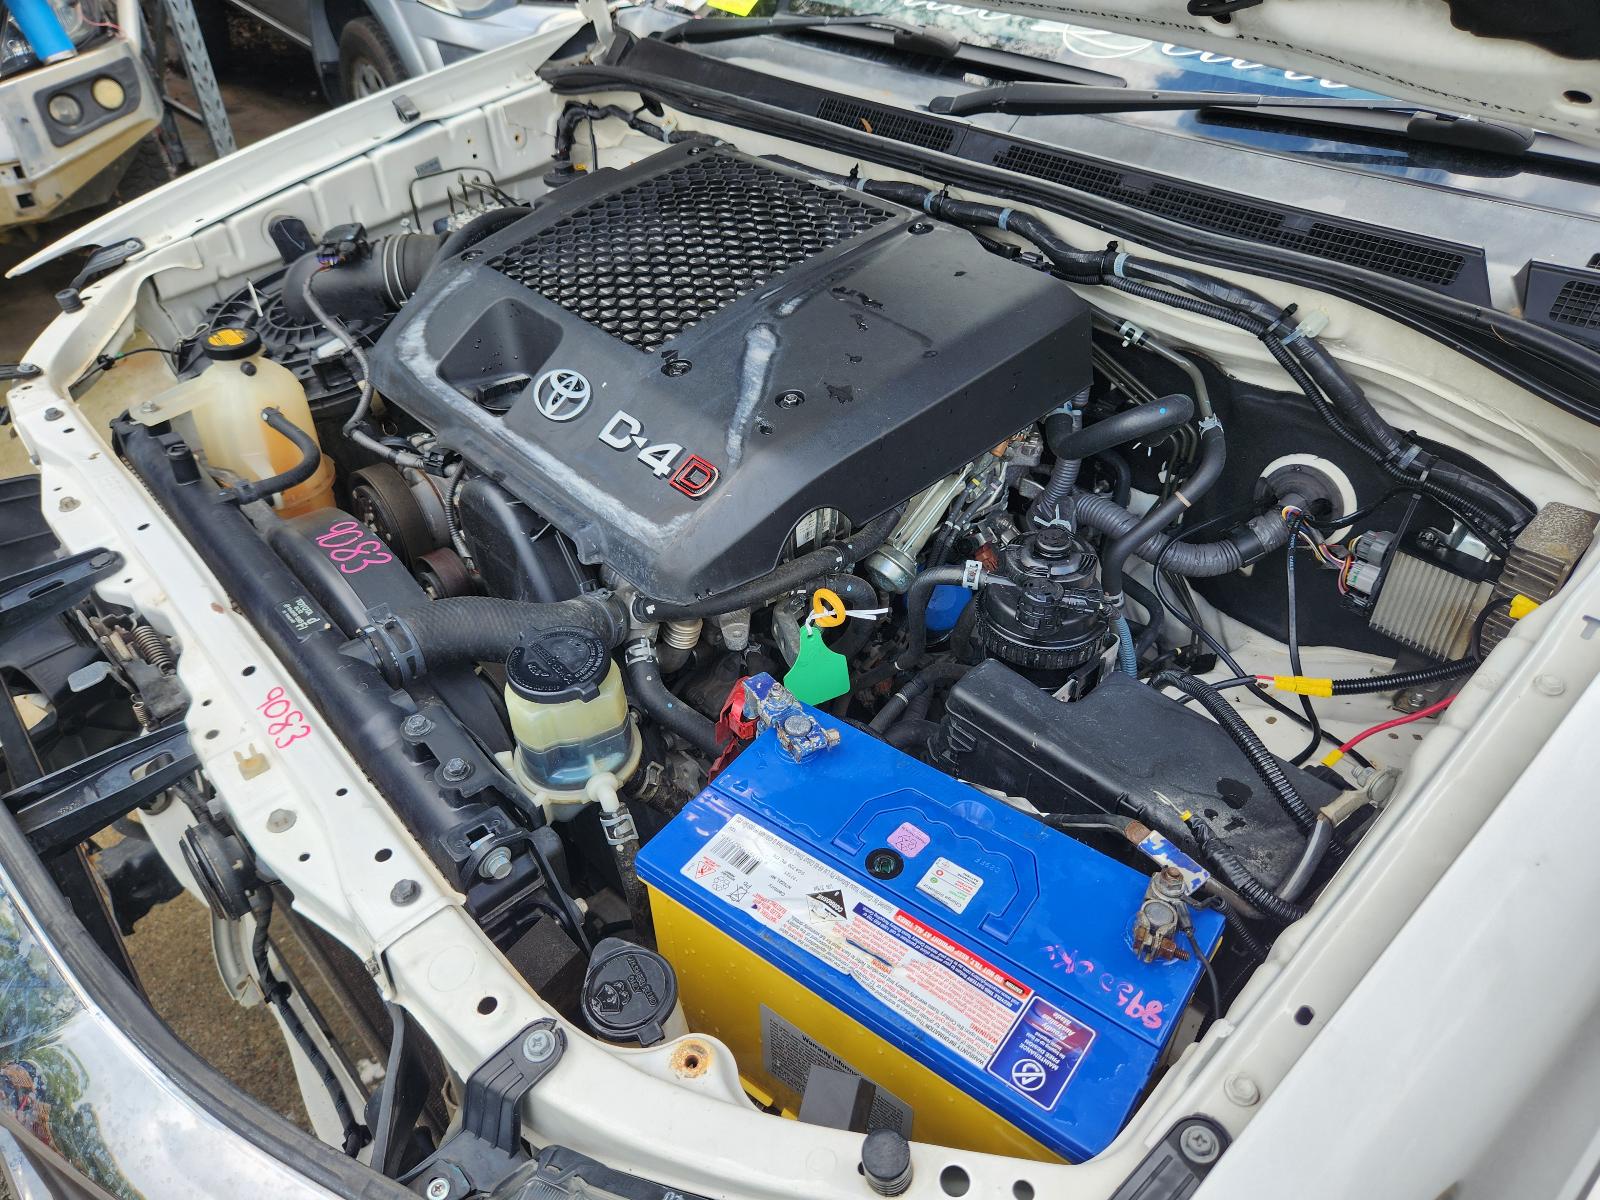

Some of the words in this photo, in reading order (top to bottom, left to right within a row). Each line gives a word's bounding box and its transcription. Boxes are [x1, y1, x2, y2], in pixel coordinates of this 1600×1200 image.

[598, 410, 720, 498] D-4D
[316, 520, 393, 574] 9083
[256, 686, 311, 749] 9083
[815, 892, 844, 913] CORROSIVE
[912, 924, 924, 934] ALL
[922, 930, 932, 939] AT
[981, 966, 995, 977] NOT
[993, 973, 1004, 982] DO
[1040, 1012, 1075, 1037] Australian
[1051, 1010, 1071, 1026] Made
[1040, 1021, 1067, 1041] Proudly
[801, 1034, 832, 1061] Warranty
[1017, 1042, 1059, 1071] MAINTENANCE
[1023, 1038, 1046, 1055] DESIGN
[1044, 1051, 1060, 1064] FREE
